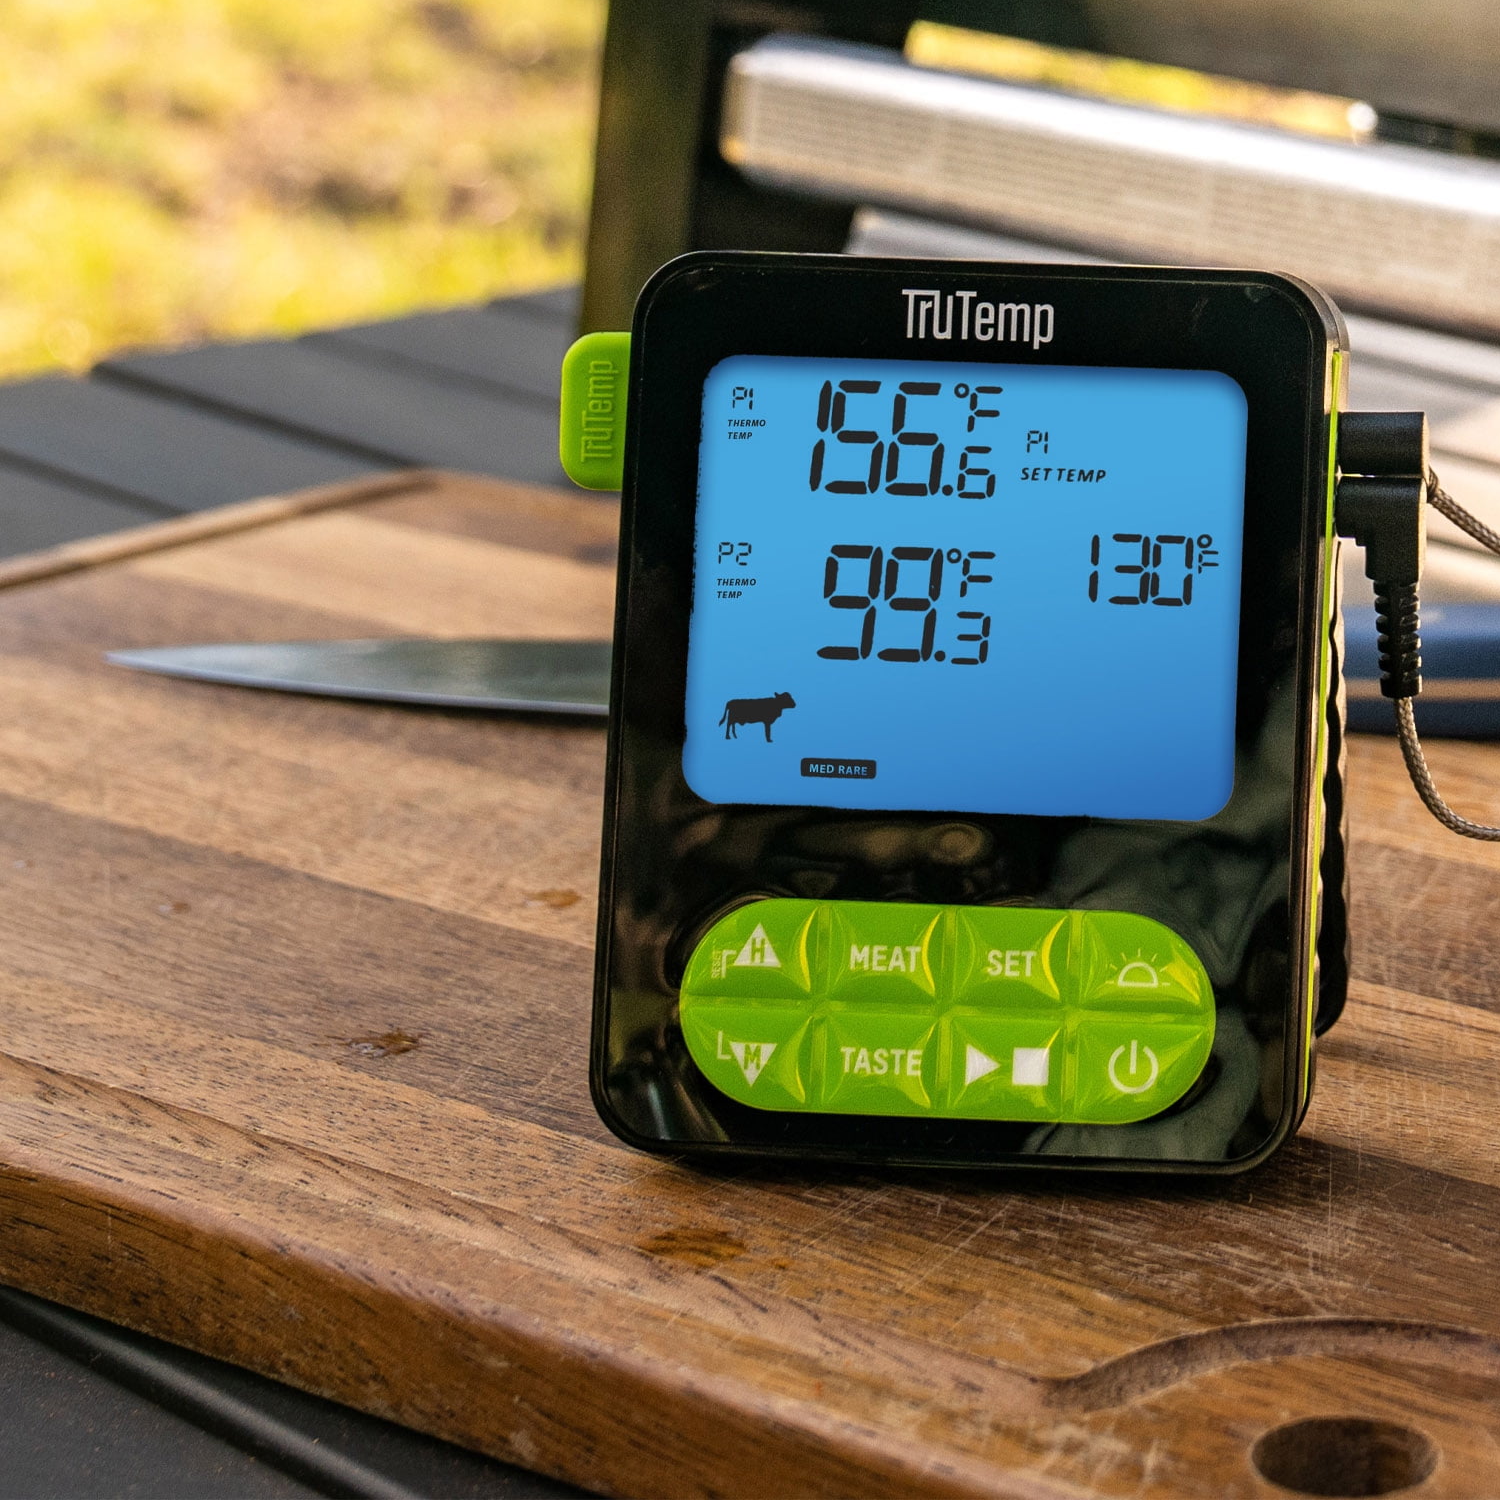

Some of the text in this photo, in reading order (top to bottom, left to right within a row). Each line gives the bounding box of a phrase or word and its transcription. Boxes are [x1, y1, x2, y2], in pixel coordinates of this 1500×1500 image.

[727, 419, 767, 427] THERMO
[727, 431, 753, 440] TEMP
[1020, 467, 1107, 483] SET TEMP
[718, 541, 752, 566] P2
[717, 578, 757, 587] THERMO
[717, 590, 743, 599] TEMP
[809, 763, 868, 776] MED RARE
[850, 944, 922, 973] MEAT
[986, 949, 1038, 977] SET
[840, 1046, 924, 1077] TASTE
